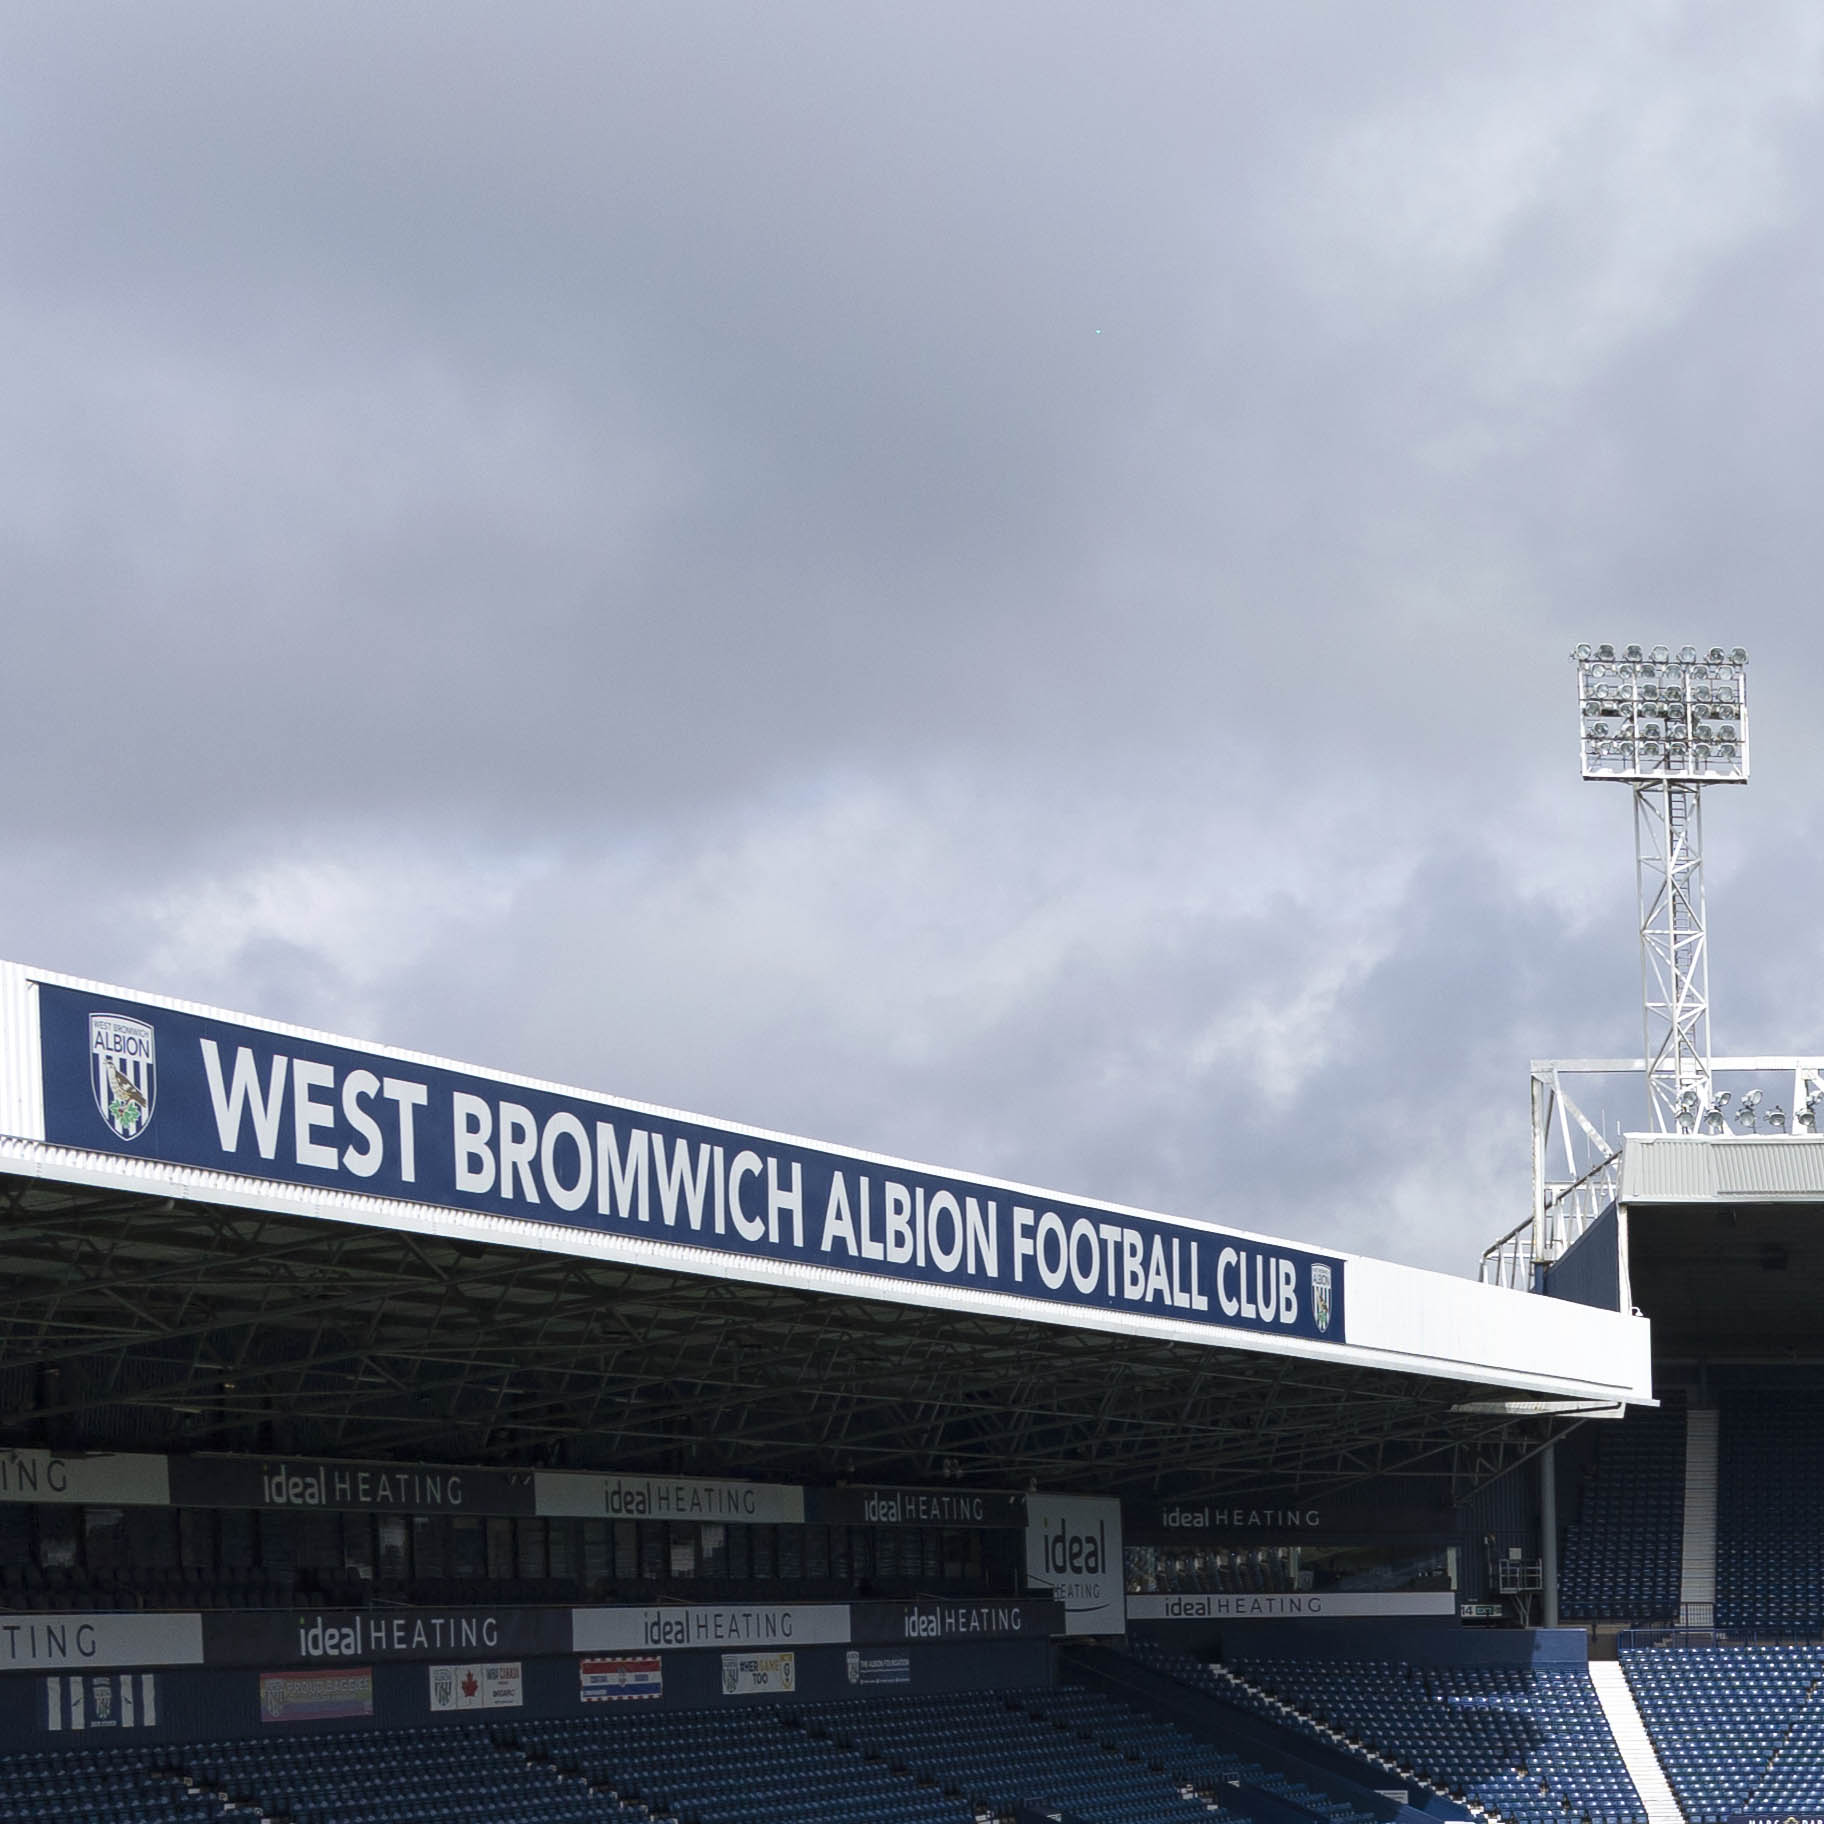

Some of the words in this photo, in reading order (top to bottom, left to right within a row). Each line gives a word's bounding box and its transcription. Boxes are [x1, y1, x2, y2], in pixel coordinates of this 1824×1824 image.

[94, 1031, 150, 1058] ALBION
[200, 1037, 427, 1182] WEST
[455, 1091, 803, 1249] BROMWICH
[820, 1170, 998, 1279] ALBION
[1012, 1205, 1209, 1312] FOOTBALL
[1217, 1246, 1299, 1325] CLUB
[263, 1464, 326, 1505] ideal
[335, 1473, 464, 1505] HEATING
[604, 1484, 652, 1515] ideal
[657, 1487, 756, 1515] HEATING
[864, 1493, 902, 1523] ideal
[904, 1496, 984, 1522] HEATING
[1161, 1506, 1210, 1528] ideal
[1215, 1510, 1320, 1528] HEATING
[1043, 1517, 1106, 1574] ideal
[903, 1606, 942, 1638] ideal
[944, 1606, 1022, 1632] HEATING
[1164, 1596, 1211, 1617] ideal
[1216, 1597, 1323, 1616] HEATING
[300, 1615, 362, 1657] ideal
[370, 1618, 499, 1651] HEATING
[644, 1612, 691, 1645] ideal
[697, 1612, 793, 1640] HEATING
[752, 1673, 769, 1685] TOO
